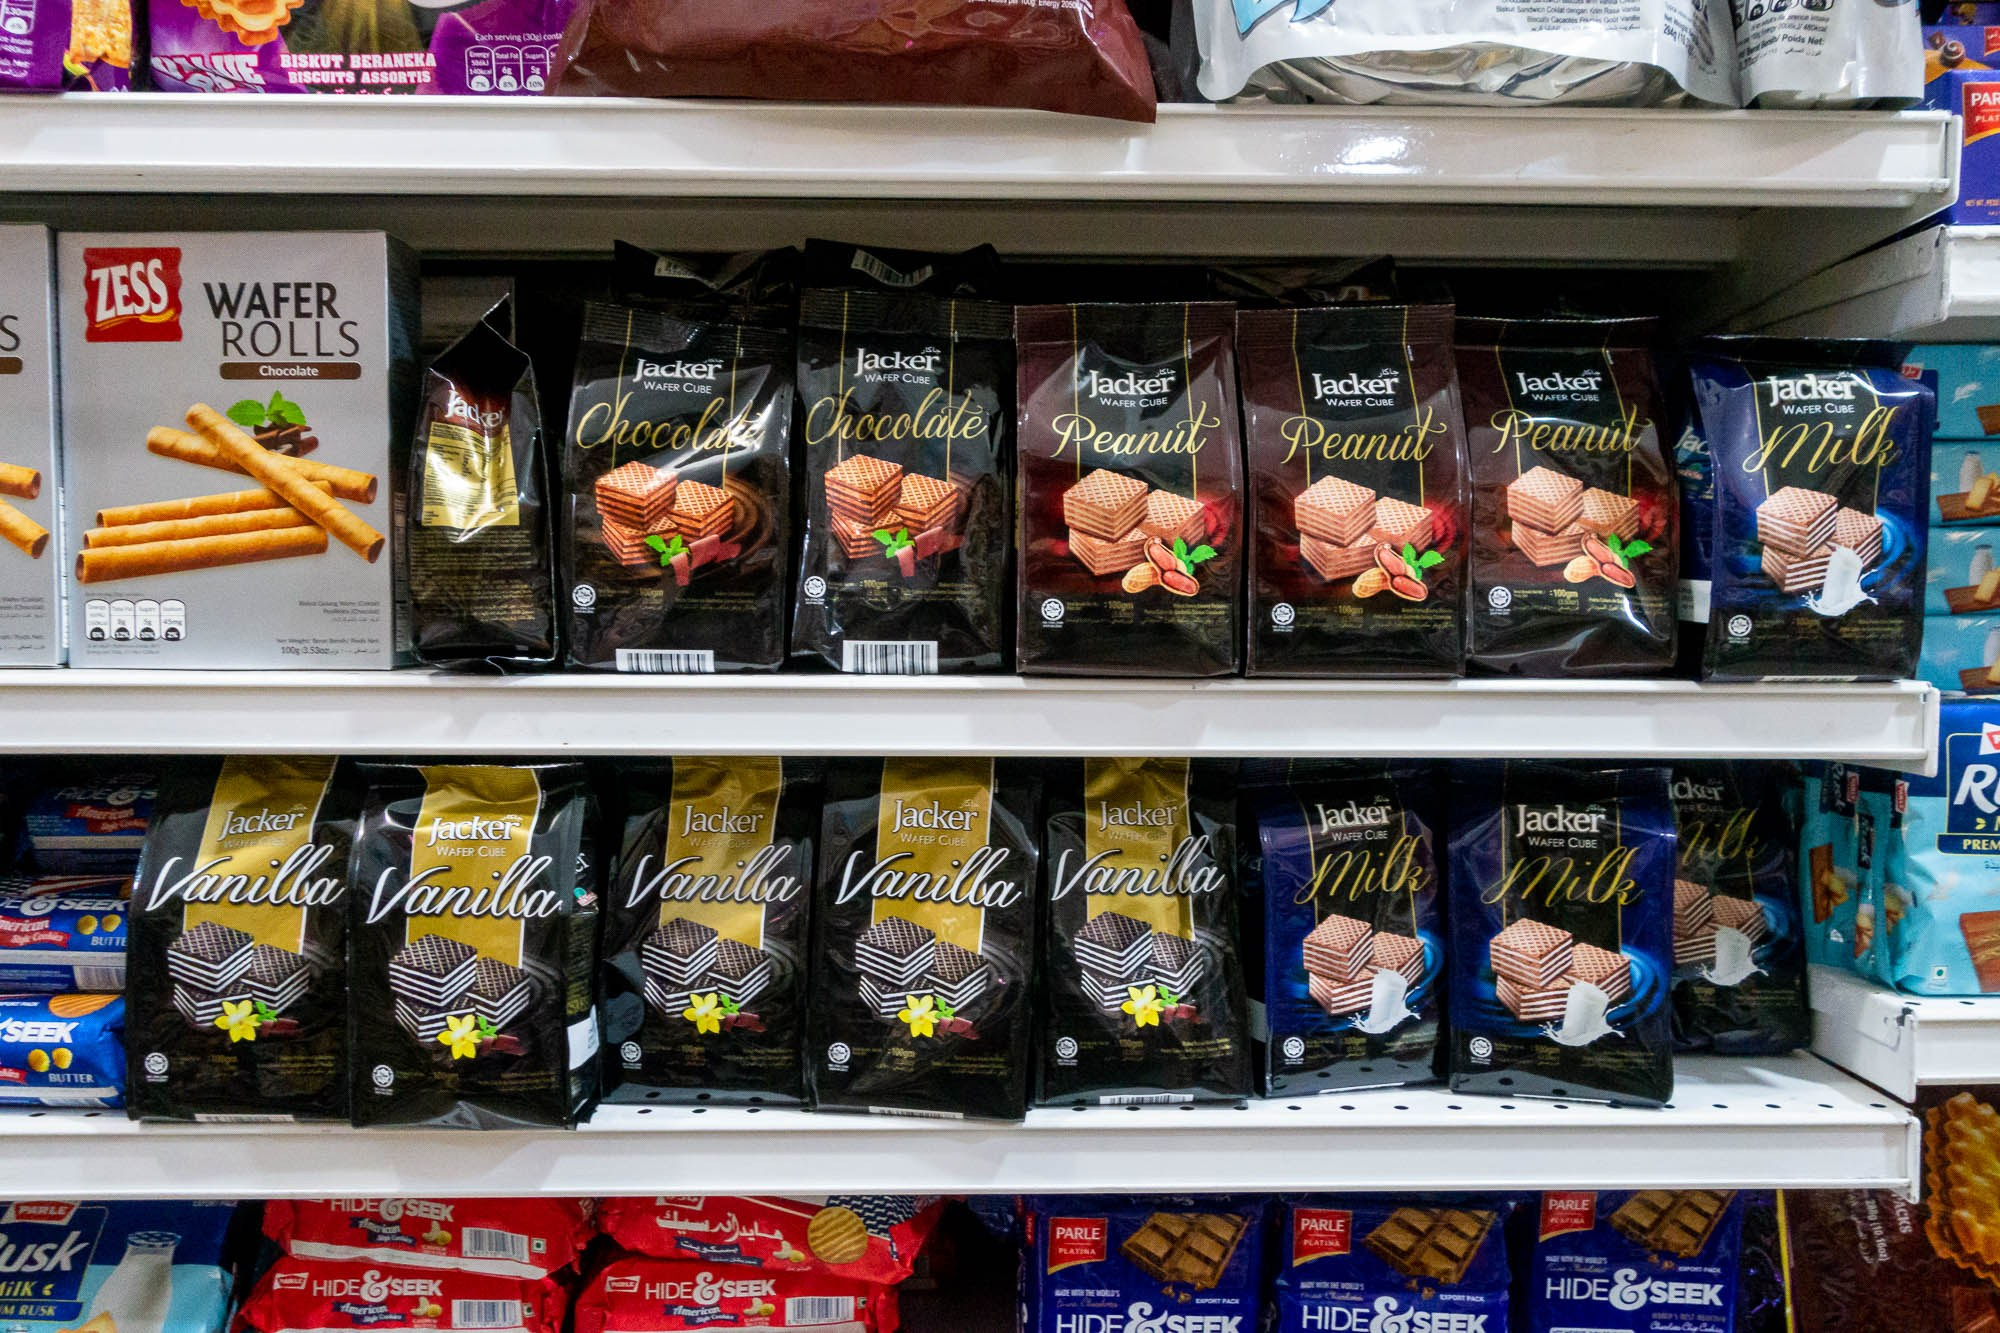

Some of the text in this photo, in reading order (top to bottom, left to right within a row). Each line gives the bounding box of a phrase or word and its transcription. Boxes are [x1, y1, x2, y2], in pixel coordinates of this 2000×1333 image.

[495, 34, 521, 42] serving
[543, 33, 564, 41] conta
[1782, 33, 1805, 43] Poids
[281, 53, 437, 69] BISKUT BERANEKA
[289, 71, 431, 84] BISCUITS ASSORTIS
[91, 259, 168, 323] ZESS
[204, 282, 340, 319] WAFER
[222, 321, 360, 357] ROLLS
[259, 365, 319, 377] Chocolate
[632, 358, 723, 383] Jacker
[854, 348, 941, 377] Jacker
[644, 381, 713, 394] WAFER CUBE
[864, 373, 931, 385] WAFER CUBE
[1088, 369, 1177, 398] Jacker
[1311, 373, 1399, 400] Jacker
[1516, 372, 1603, 395] Jacker
[1769, 374, 1857, 407] Jacker
[1100, 397, 1168, 408] WAFER CUBE
[1326, 398, 1394, 407] WAFER CUBE
[1531, 393, 1600, 402] WAFER CUBE
[1782, 402, 1855, 414] WAFER CUBE
[806, 386, 988, 445] Chocolate
[1050, 400, 1221, 458] Peanut
[1490, 403, 1655, 454] Peanut
[1281, 406, 1447, 464] Peanut
[1742, 406, 1898, 473] Milk
[217, 808, 306, 842] Jacker
[681, 805, 764, 837] Jacker
[892, 799, 978, 833] Jacker
[1100, 800, 1178, 832] Jacker
[1315, 801, 1392, 834] Jacker
[1516, 804, 1607, 837] Jacker
[427, 816, 521, 847] Jacker
[1331, 830, 1389, 842] WAFER CUBE
[1528, 836, 1598, 849] WAFER CUBE
[436, 845, 507, 857] WAFER CUBE
[144, 843, 346, 912] Vanilla
[625, 844, 803, 909] Vanilla
[834, 845, 1022, 908] Vanilla
[1050, 834, 1226, 901] Vanilla
[1294, 834, 1432, 905] Milk
[1480, 846, 1645, 908] Milk
[366, 854, 564, 924] Vanilla
[48, 1073, 94, 1083] BUTTER
[19, 1204, 70, 1216] PARLE
[1551, 1198, 1589, 1211] PARLE
[1056, 1227, 1101, 1240] PARLE
[1301, 1218, 1345, 1233] PARLE
[1303, 1239, 1341, 1247] PLATINA
[19, 1304, 55, 1316] RUSK
[340, 1302, 389, 1313] American
[673, 1305, 721, 1316] American
